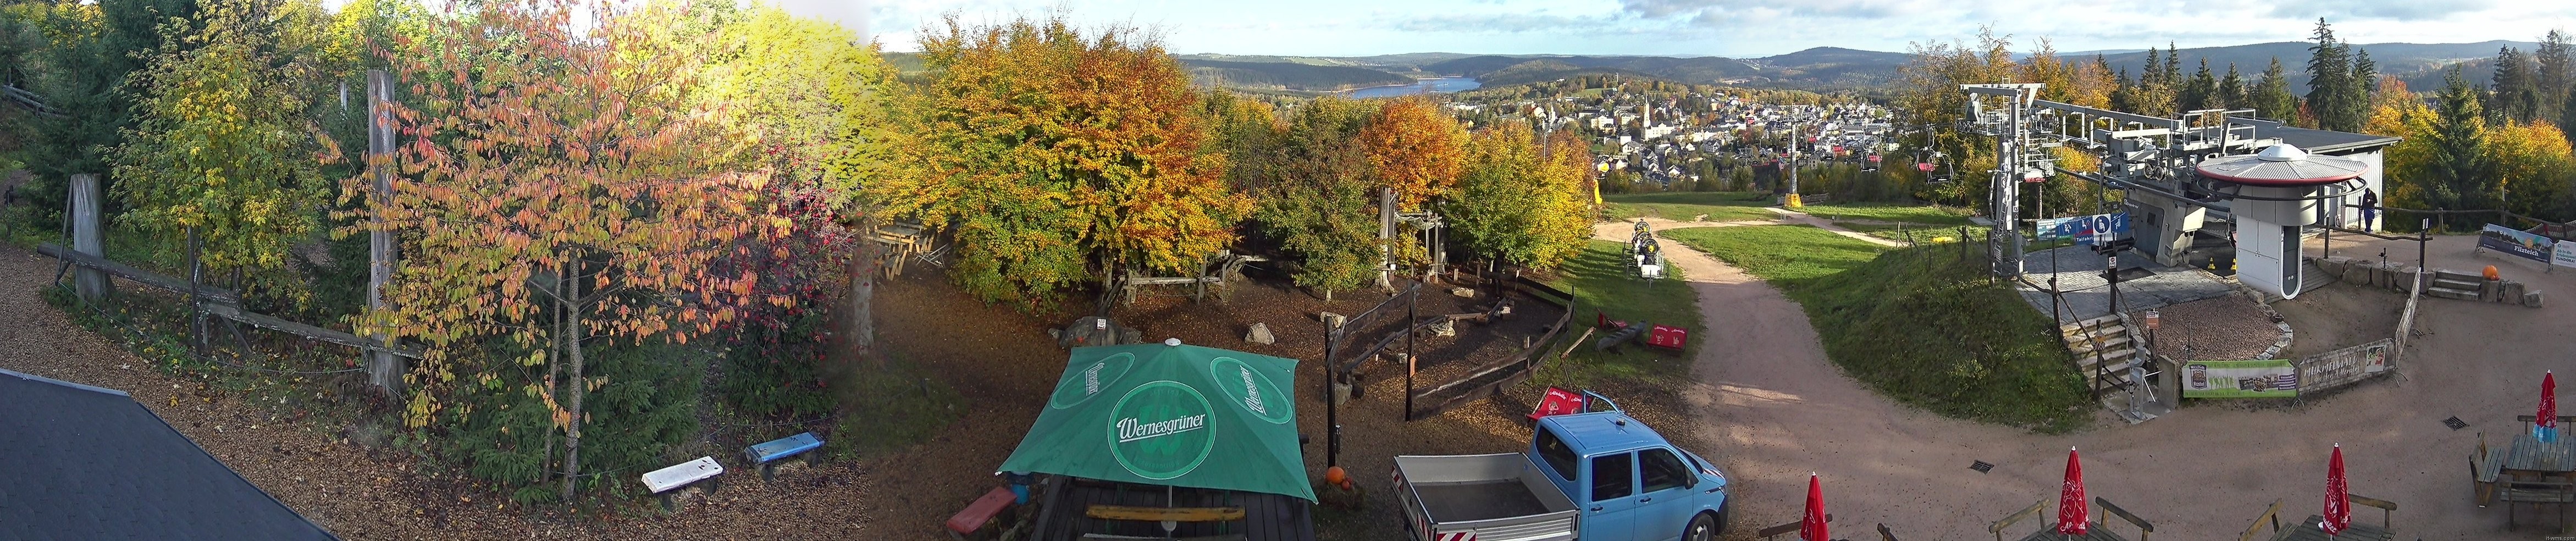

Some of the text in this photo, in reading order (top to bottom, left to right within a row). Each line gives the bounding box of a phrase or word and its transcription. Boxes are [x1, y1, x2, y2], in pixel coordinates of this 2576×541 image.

[2514, 246, 2539, 256] Filzteich
[1239, 365, 1264, 413] Wernesgrüner
[1116, 414, 1206, 439] Wernesgrüner
